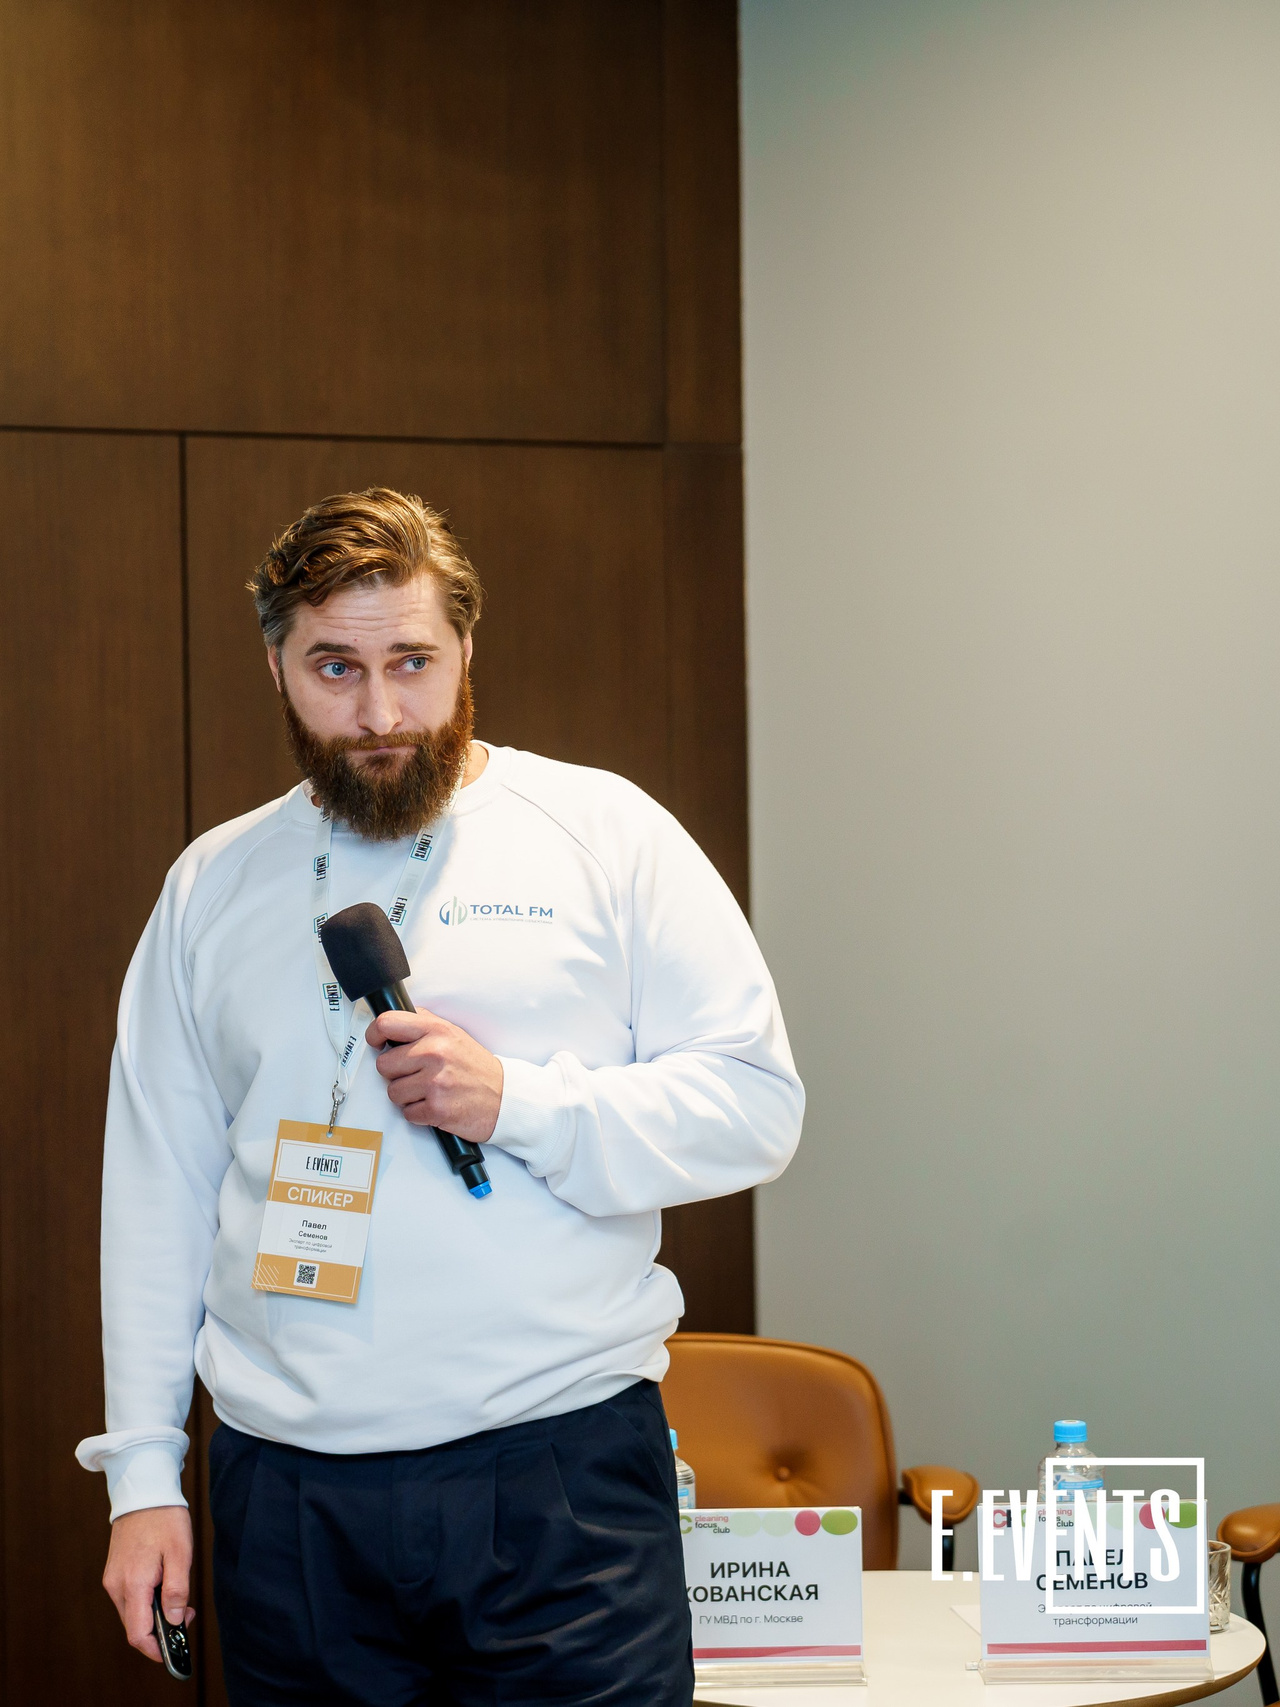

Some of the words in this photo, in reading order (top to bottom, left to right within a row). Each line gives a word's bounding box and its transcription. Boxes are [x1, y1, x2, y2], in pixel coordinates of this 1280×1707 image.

[470, 904, 524, 916] TOTAL
[529, 906, 553, 918] FM
[306, 1156, 339, 1174] E.EVENTS
[287, 1186, 354, 1207] СПИКЕР
[301, 1219, 327, 1230] Павел
[298, 1230, 328, 1240] Семенов
[694, 1514, 729, 1523] cleaning
[1056, 1520, 1074, 1528] club
[695, 1521, 718, 1529] focus
[710, 1561, 791, 1579] ИРИНА
[699, 1616, 712, 1625] ГУ
[714, 1615, 738, 1625] МВД
[740, 1616, 752, 1624] по
[763, 1614, 804, 1624] Москве
[1053, 1616, 1138, 1627] трансформации
